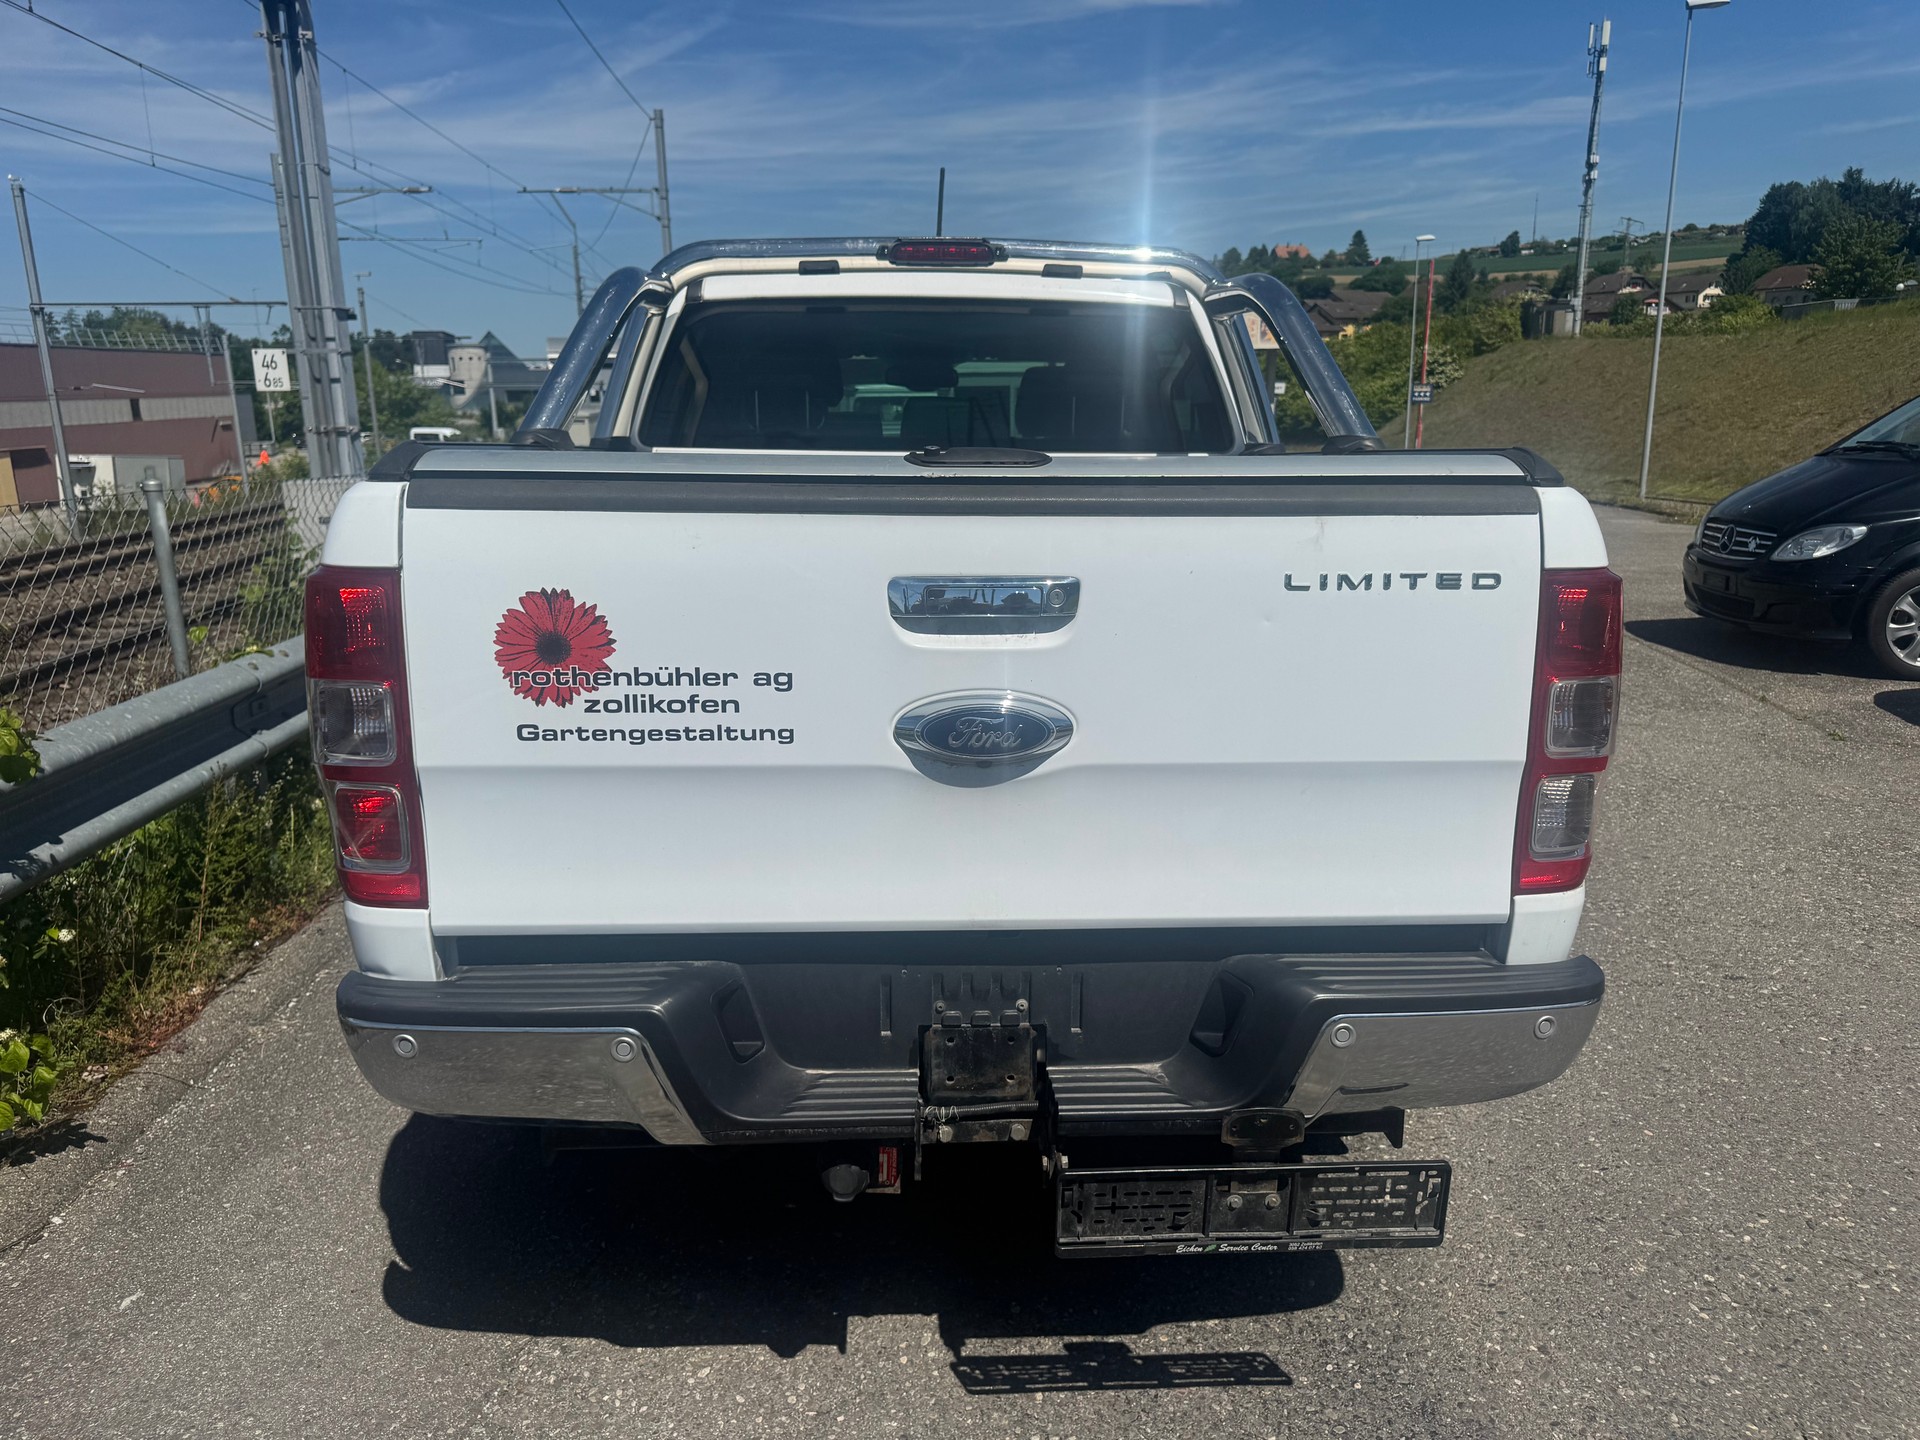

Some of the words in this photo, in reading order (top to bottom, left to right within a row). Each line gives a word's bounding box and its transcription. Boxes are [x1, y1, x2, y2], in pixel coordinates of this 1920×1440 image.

[262, 354, 278, 370] 46
[1283, 572, 1502, 592] LIMITED
[512, 666, 739, 687] rothenbühler
[752, 672, 793, 692] ag
[583, 694, 740, 713] zollikofen
[516, 724, 795, 745] Gartengestaltung
[948, 716, 1023, 748] Ford
[1176, 1244, 1203, 1253] Eichen
[1218, 1243, 1249, 1252] Service
[1251, 1242, 1278, 1251] Center
